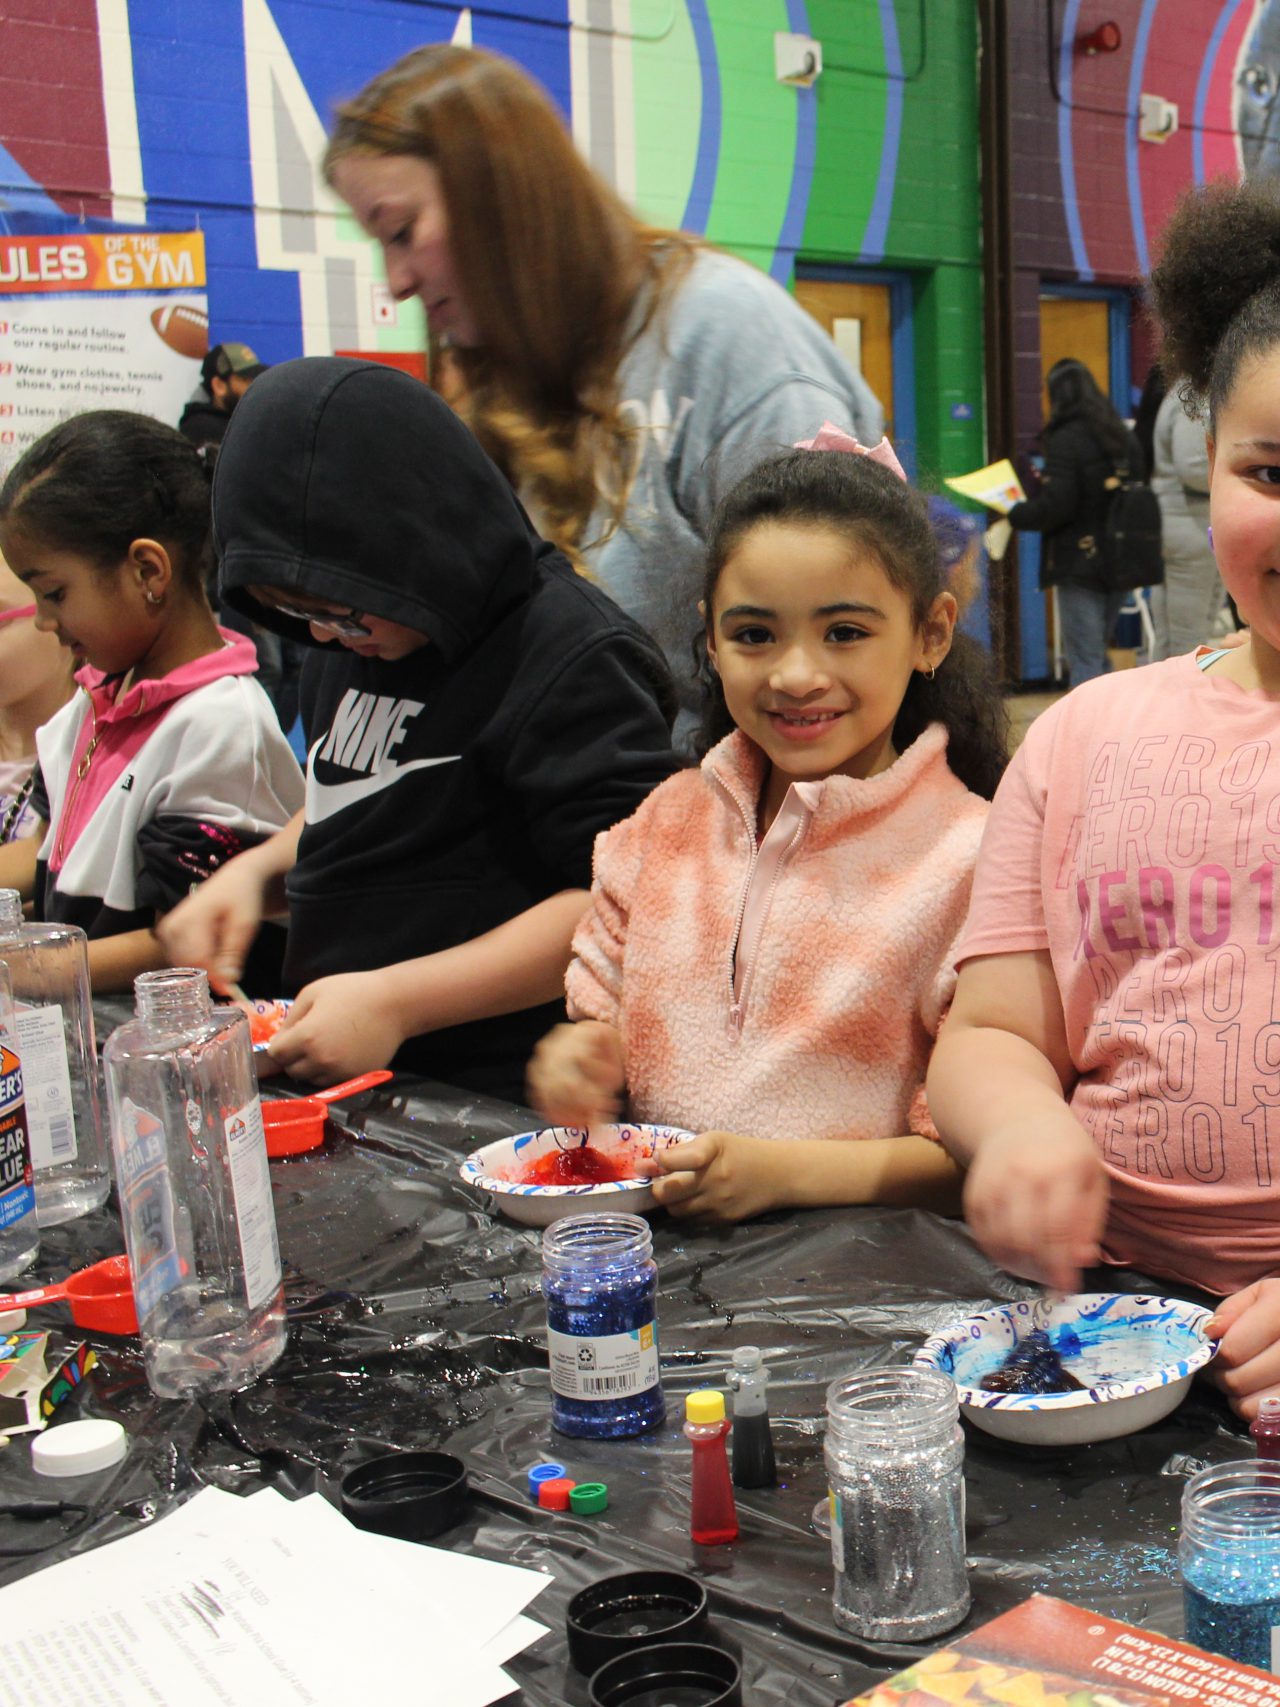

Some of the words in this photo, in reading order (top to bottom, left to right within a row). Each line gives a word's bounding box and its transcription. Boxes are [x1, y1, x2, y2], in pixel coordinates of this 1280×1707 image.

[104, 236, 127, 253] OF
[129, 235, 160, 253] THE
[0, 245, 88, 283] ULES
[106, 251, 195, 286] GYM
[12, 323, 48, 335] Come
[52, 324, 64, 335] in
[67, 326, 88, 338] and
[91, 326, 126, 340] follow
[13, 339, 34, 349] our
[38, 339, 81, 353] regular
[15, 363, 47, 376] Wear
[51, 368, 77, 381] gym
[80, 368, 125, 382] clothes,
[127, 371, 163, 382] tennis
[16, 378, 56, 391] shoes,
[59, 380, 81, 391] and
[84, 384, 98, 393] no
[17, 404, 55, 417] Listen
[319, 688, 426, 776] NIKE
[0, 1070, 23, 1102] ER'S
[0, 1127, 25, 1159] EAR
[0, 1153, 24, 1187] LUE
[1103, 1645, 1127, 1659] IN
[1168, 1651, 1184, 1663] X
[1154, 1662, 1172, 1674] X
[1165, 1666, 1188, 1680] IN
[1182, 1655, 1226, 1676] 7.6cm
[1183, 1672, 1200, 1683] 3
[1193, 1675, 1210, 1687] X
[1221, 1669, 1238, 1681] X
[1141, 1673, 1200, 1699] GALLON
[1204, 1679, 1228, 1693] IN
